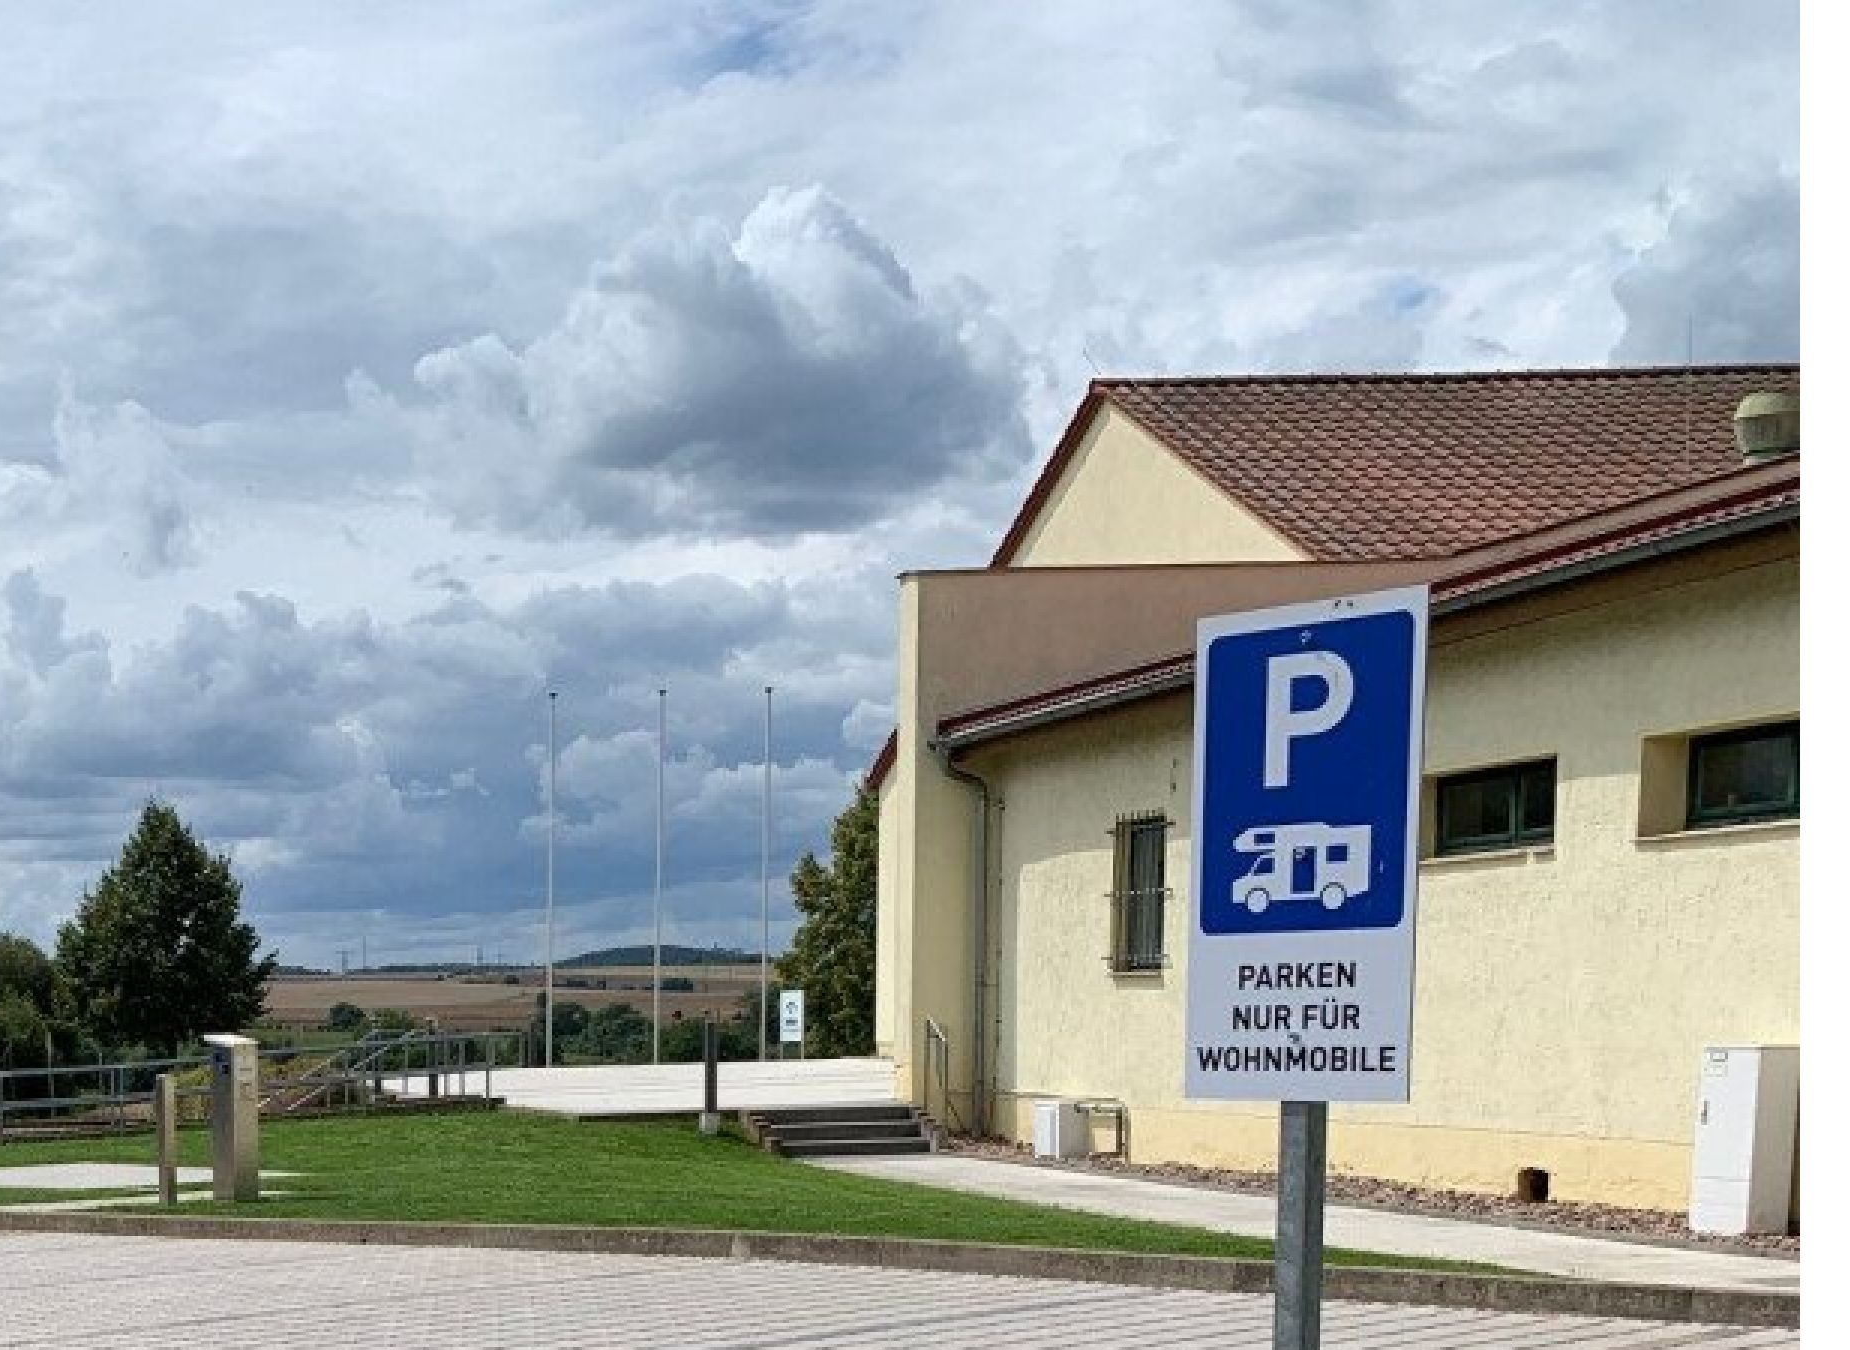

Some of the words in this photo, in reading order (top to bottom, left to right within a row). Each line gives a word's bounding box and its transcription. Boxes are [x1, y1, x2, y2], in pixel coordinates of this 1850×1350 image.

[1264, 651, 1354, 787] P
[1238, 962, 1358, 990] PARKEN
[1232, 1004, 1292, 1031] NUR
[1301, 999, 1361, 1031] FÜR
[1196, 1045, 1397, 1073] WOHNMOBILE
